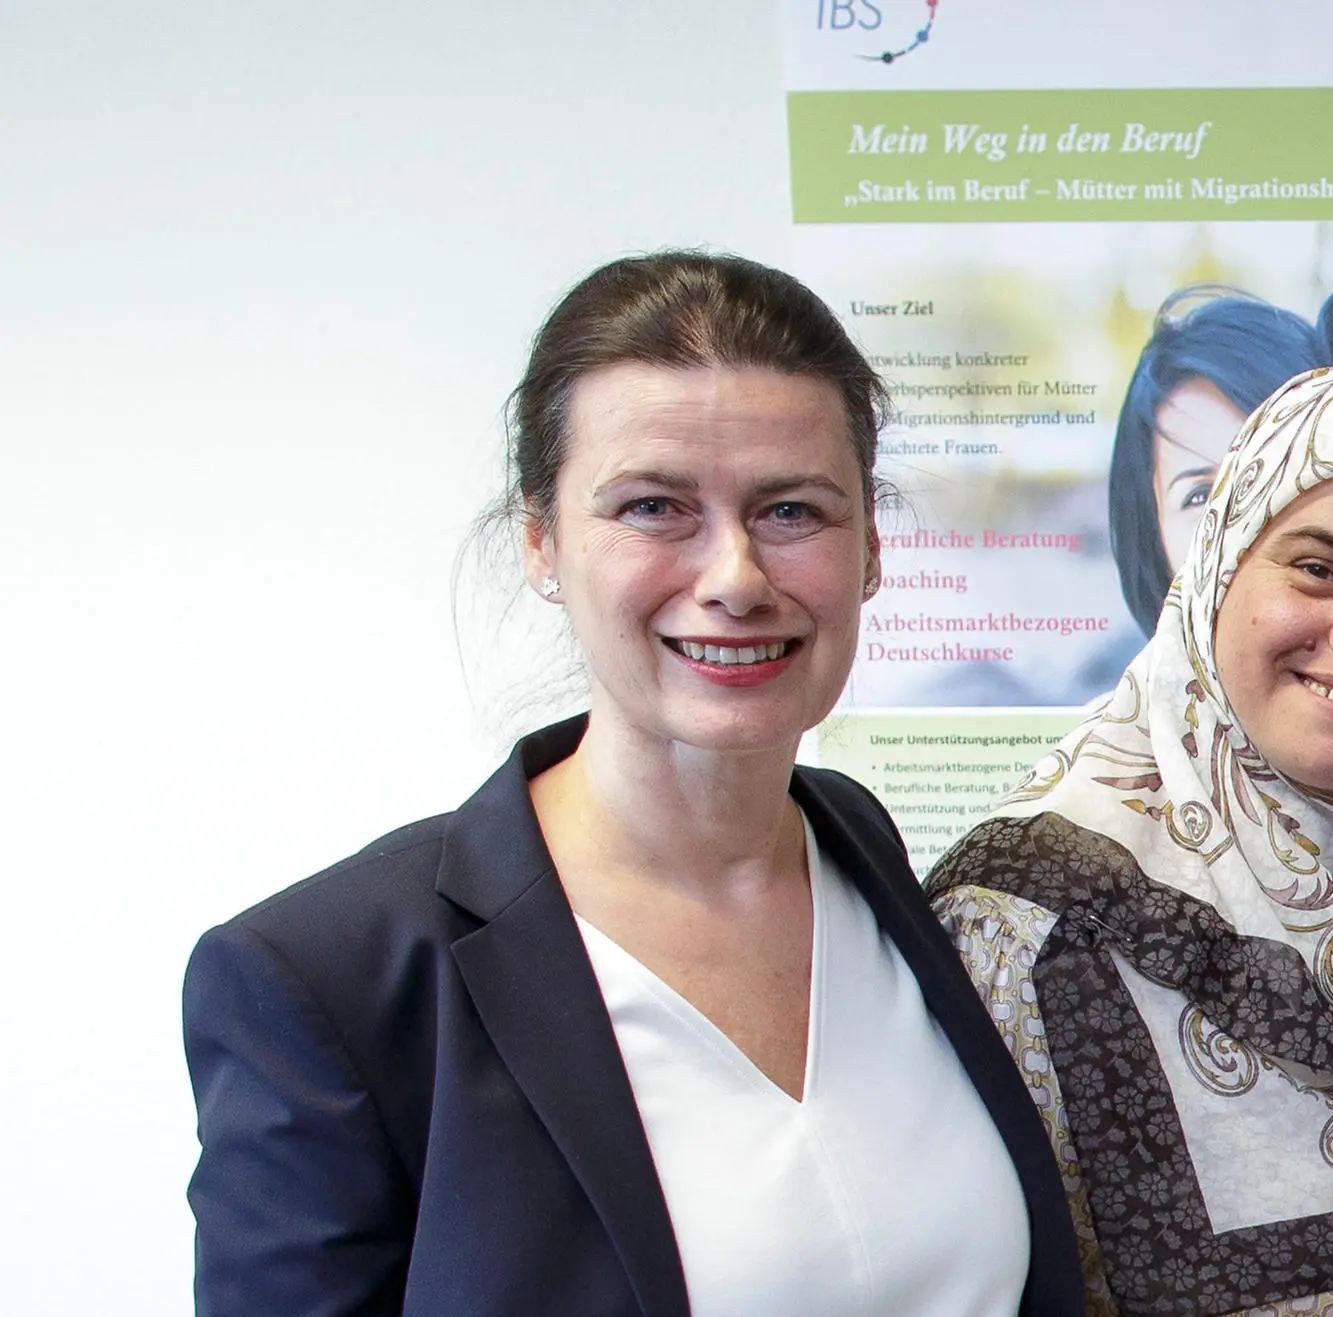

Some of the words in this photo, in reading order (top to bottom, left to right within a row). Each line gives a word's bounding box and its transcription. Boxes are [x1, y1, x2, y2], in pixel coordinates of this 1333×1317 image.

[817, 0, 882, 30] IBS
[849, 124, 928, 154] Mein
[942, 122, 1009, 161] Weg
[1016, 124, 1047, 153] in
[1056, 121, 1111, 153] den
[1120, 121, 1213, 160] Beruf
[927, 179, 957, 201] im
[963, 178, 1030, 201] Beruf
[1056, 177, 1137, 200] Mütter
[1144, 177, 1183, 200] mit
[850, 301, 898, 316] Unser
[902, 301, 935, 316] Ziel
[865, 351, 951, 369] ntwicklung
[955, 352, 1029, 367] konkreter
[1017, 381, 1040, 396] für
[1044, 381, 1097, 396] Mütter
[1066, 410, 1096, 425] und
[944, 440, 1003, 455] Frauen.
[880, 529, 976, 549] erufliche
[982, 529, 1083, 552] Beratung
[882, 570, 968, 593] oaching
[865, 612, 1110, 635] Arbeitsmarktbezogene
[867, 642, 1015, 662] Deutschkurse
[870, 734, 904, 746] Unser
[907, 733, 1042, 748] Unterstützungsangebot
[884, 762, 1011, 775] Arbeitsmarktbezogene
[884, 782, 940, 794] Berufliche
[944, 782, 1000, 795] Beratung,
